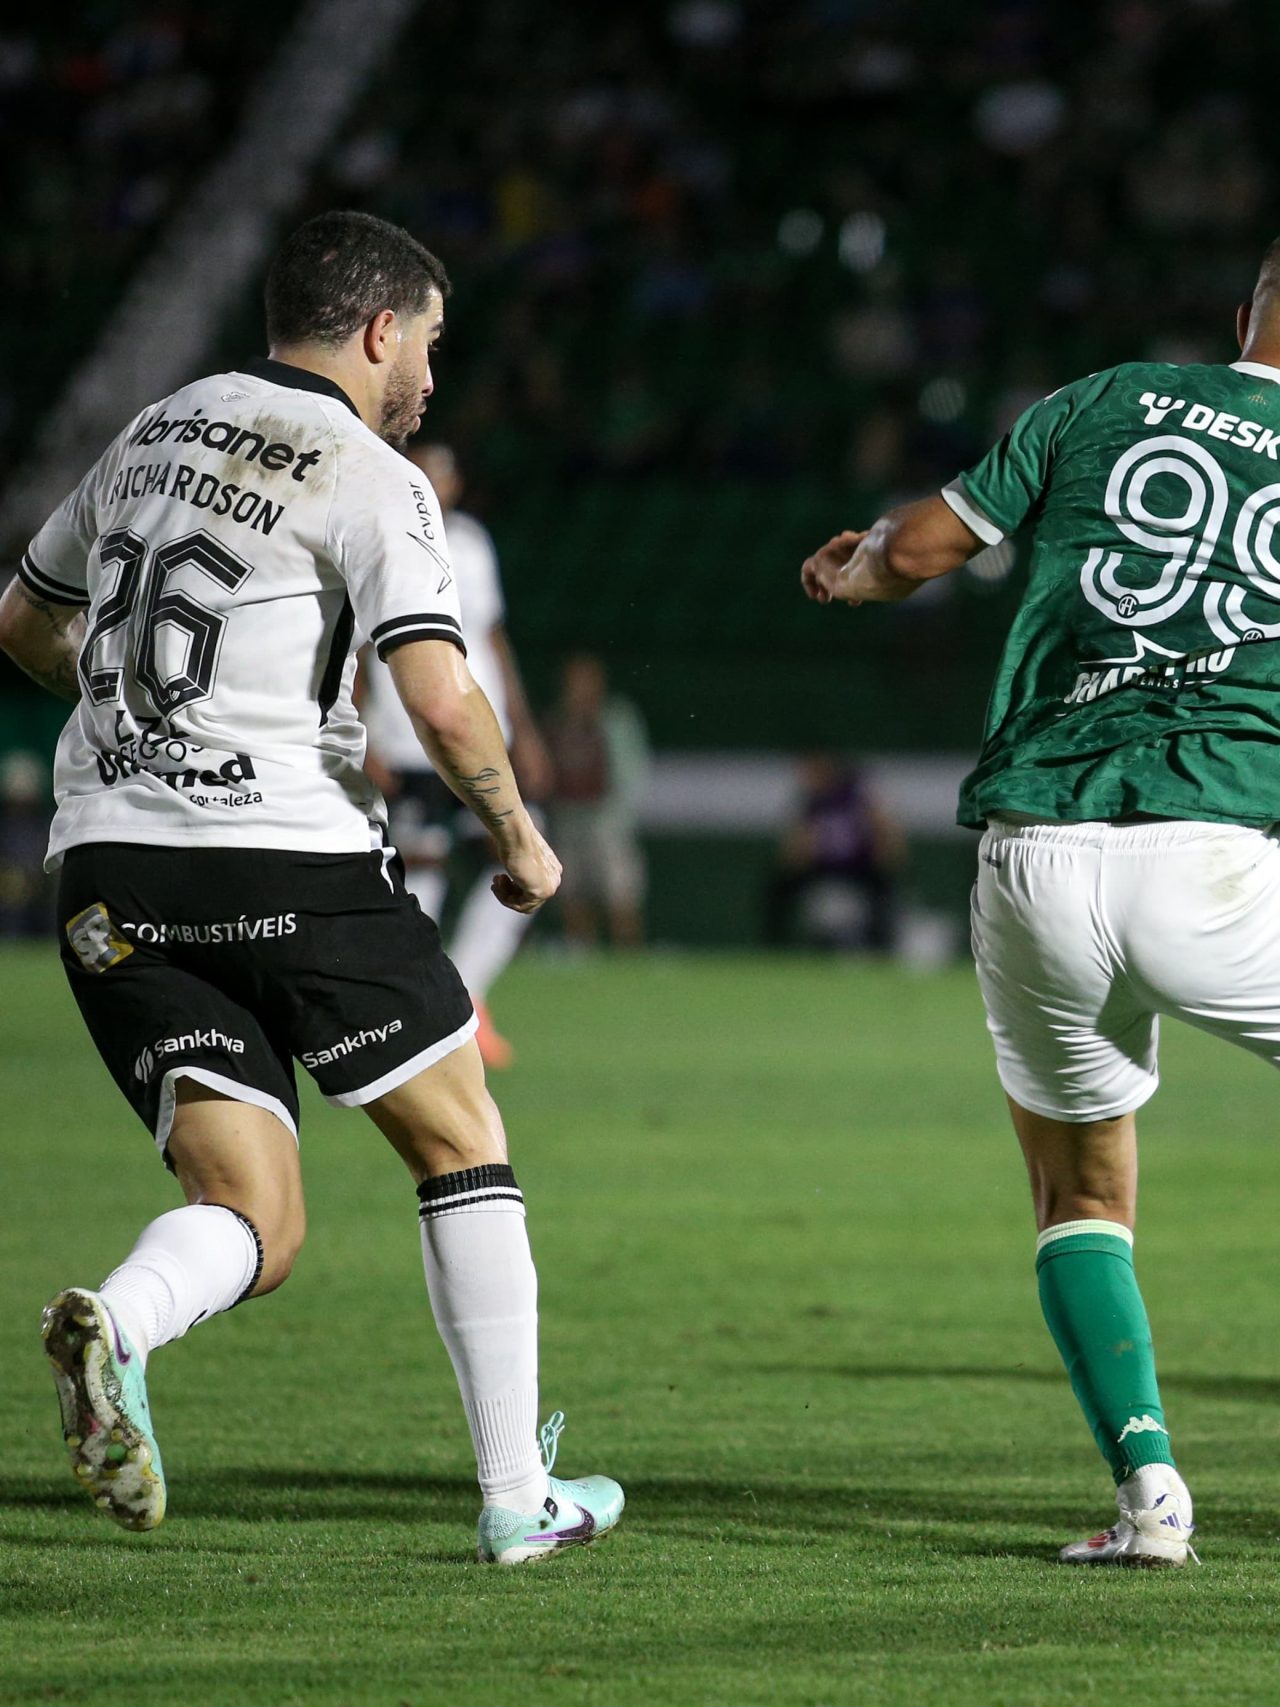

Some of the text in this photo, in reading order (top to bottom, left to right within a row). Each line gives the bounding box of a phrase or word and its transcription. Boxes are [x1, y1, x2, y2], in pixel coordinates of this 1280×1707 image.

[137, 408, 322, 482] brisanet
[109, 460, 286, 536] RICHARDSON
[77, 526, 255, 720] 26
[154, 1028, 245, 1059] Sankhya
[302, 1019, 403, 1069] Sankhya
